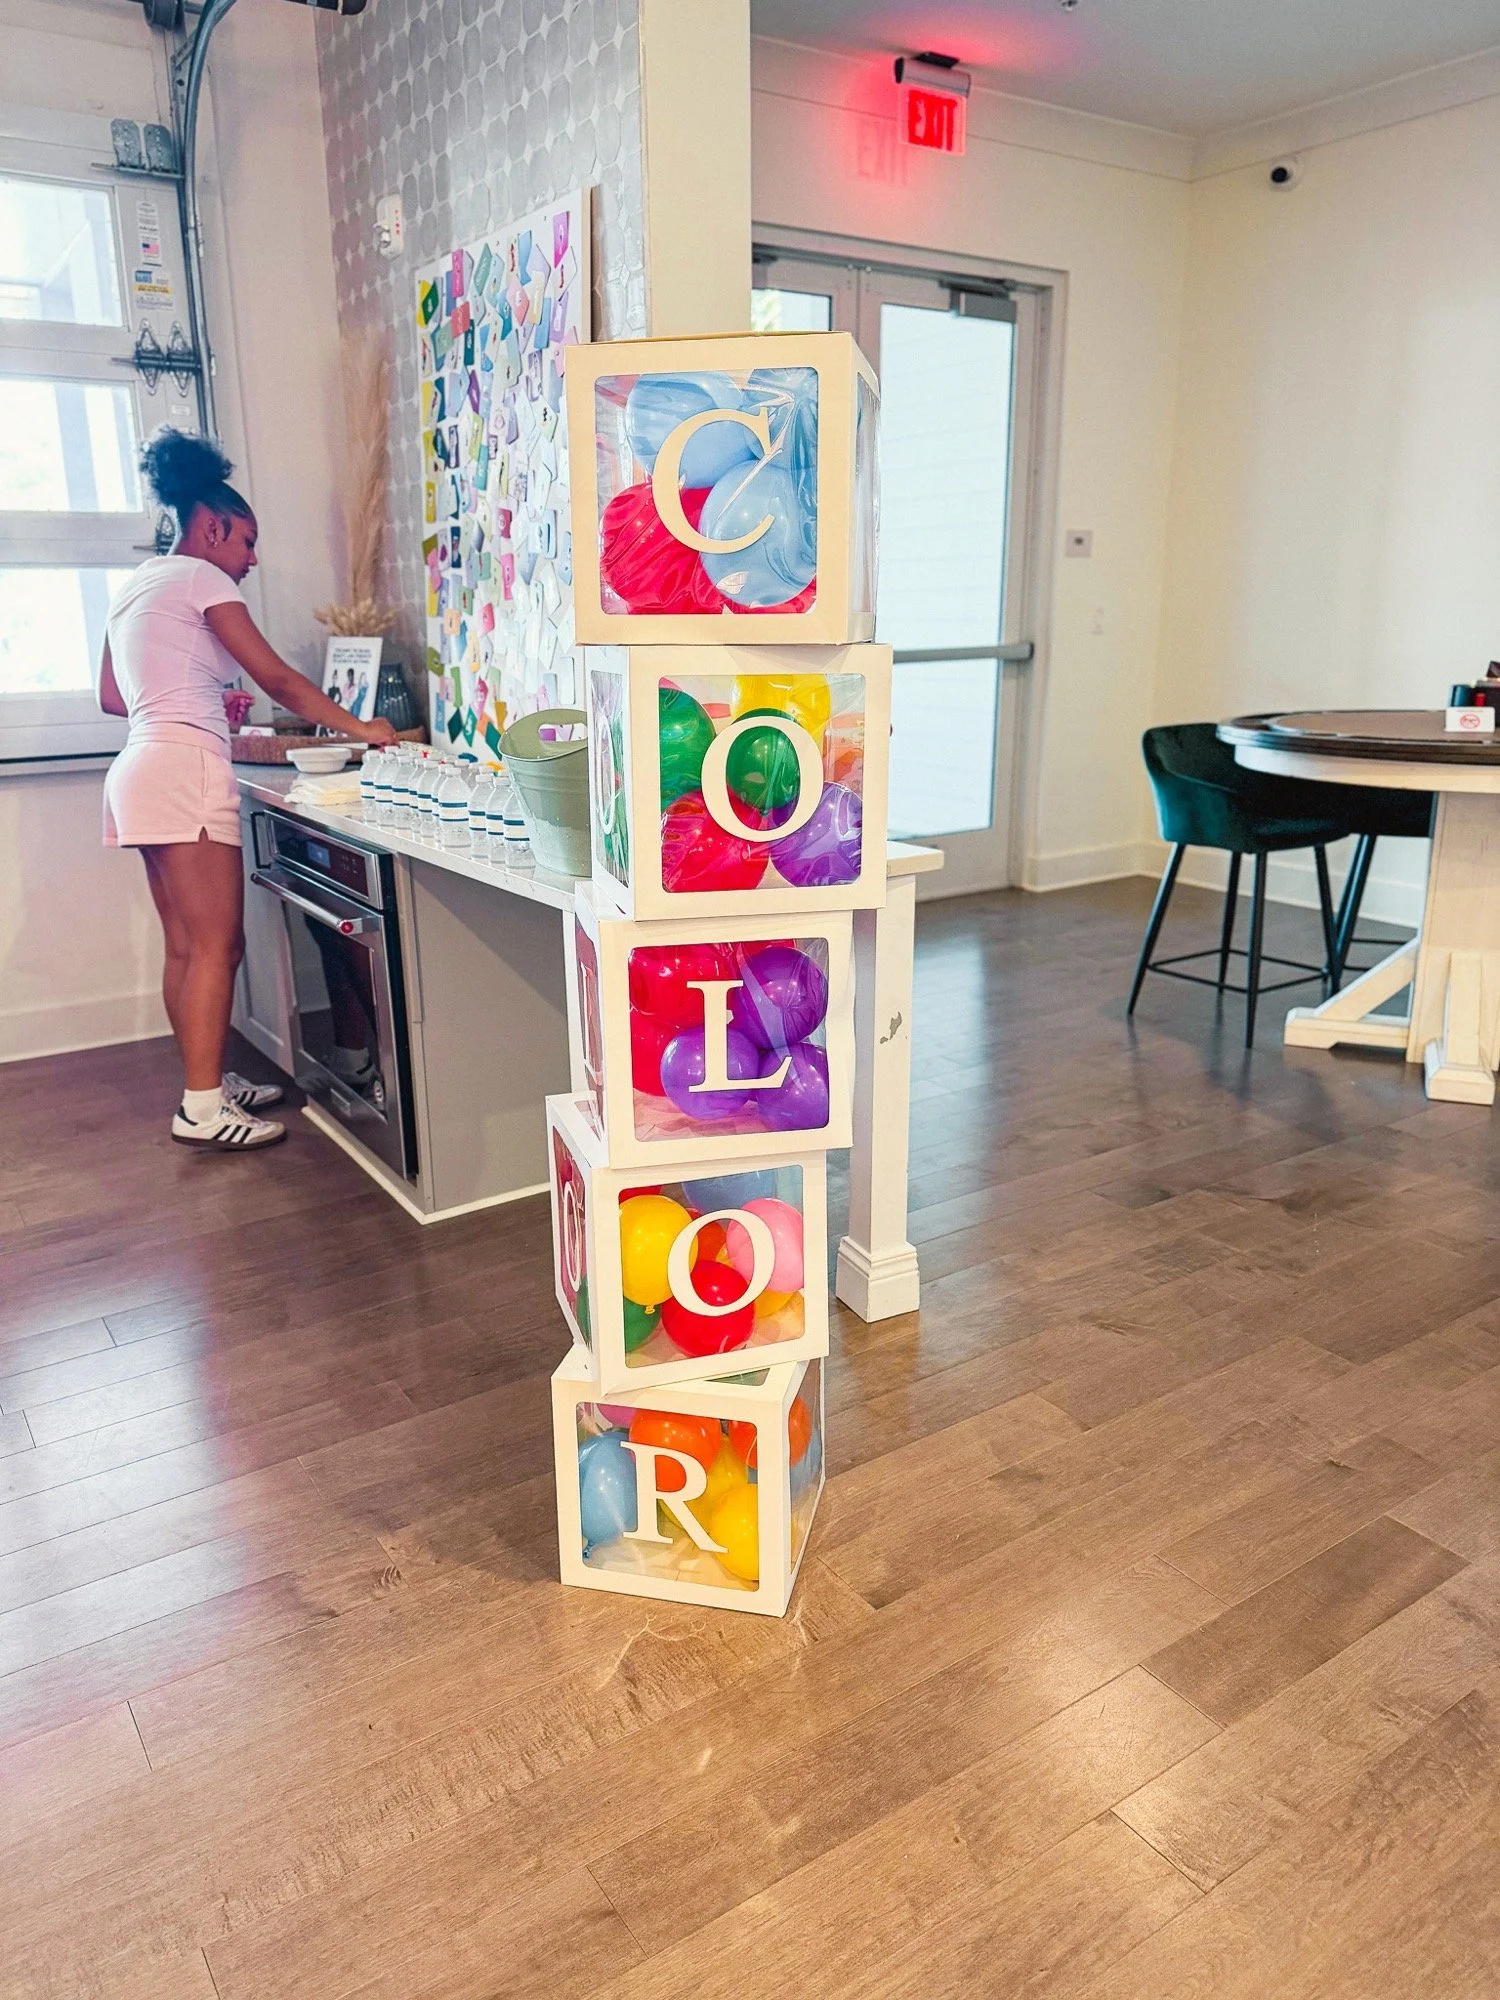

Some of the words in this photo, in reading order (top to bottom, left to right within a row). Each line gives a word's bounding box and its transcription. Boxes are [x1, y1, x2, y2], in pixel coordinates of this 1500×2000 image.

[907, 89, 958, 152] EXIT
[652, 406, 775, 554] C
[701, 715, 825, 843] O
[686, 980, 794, 1093] L
[667, 1208, 777, 1317] O
[620, 1440, 729, 1554] R
